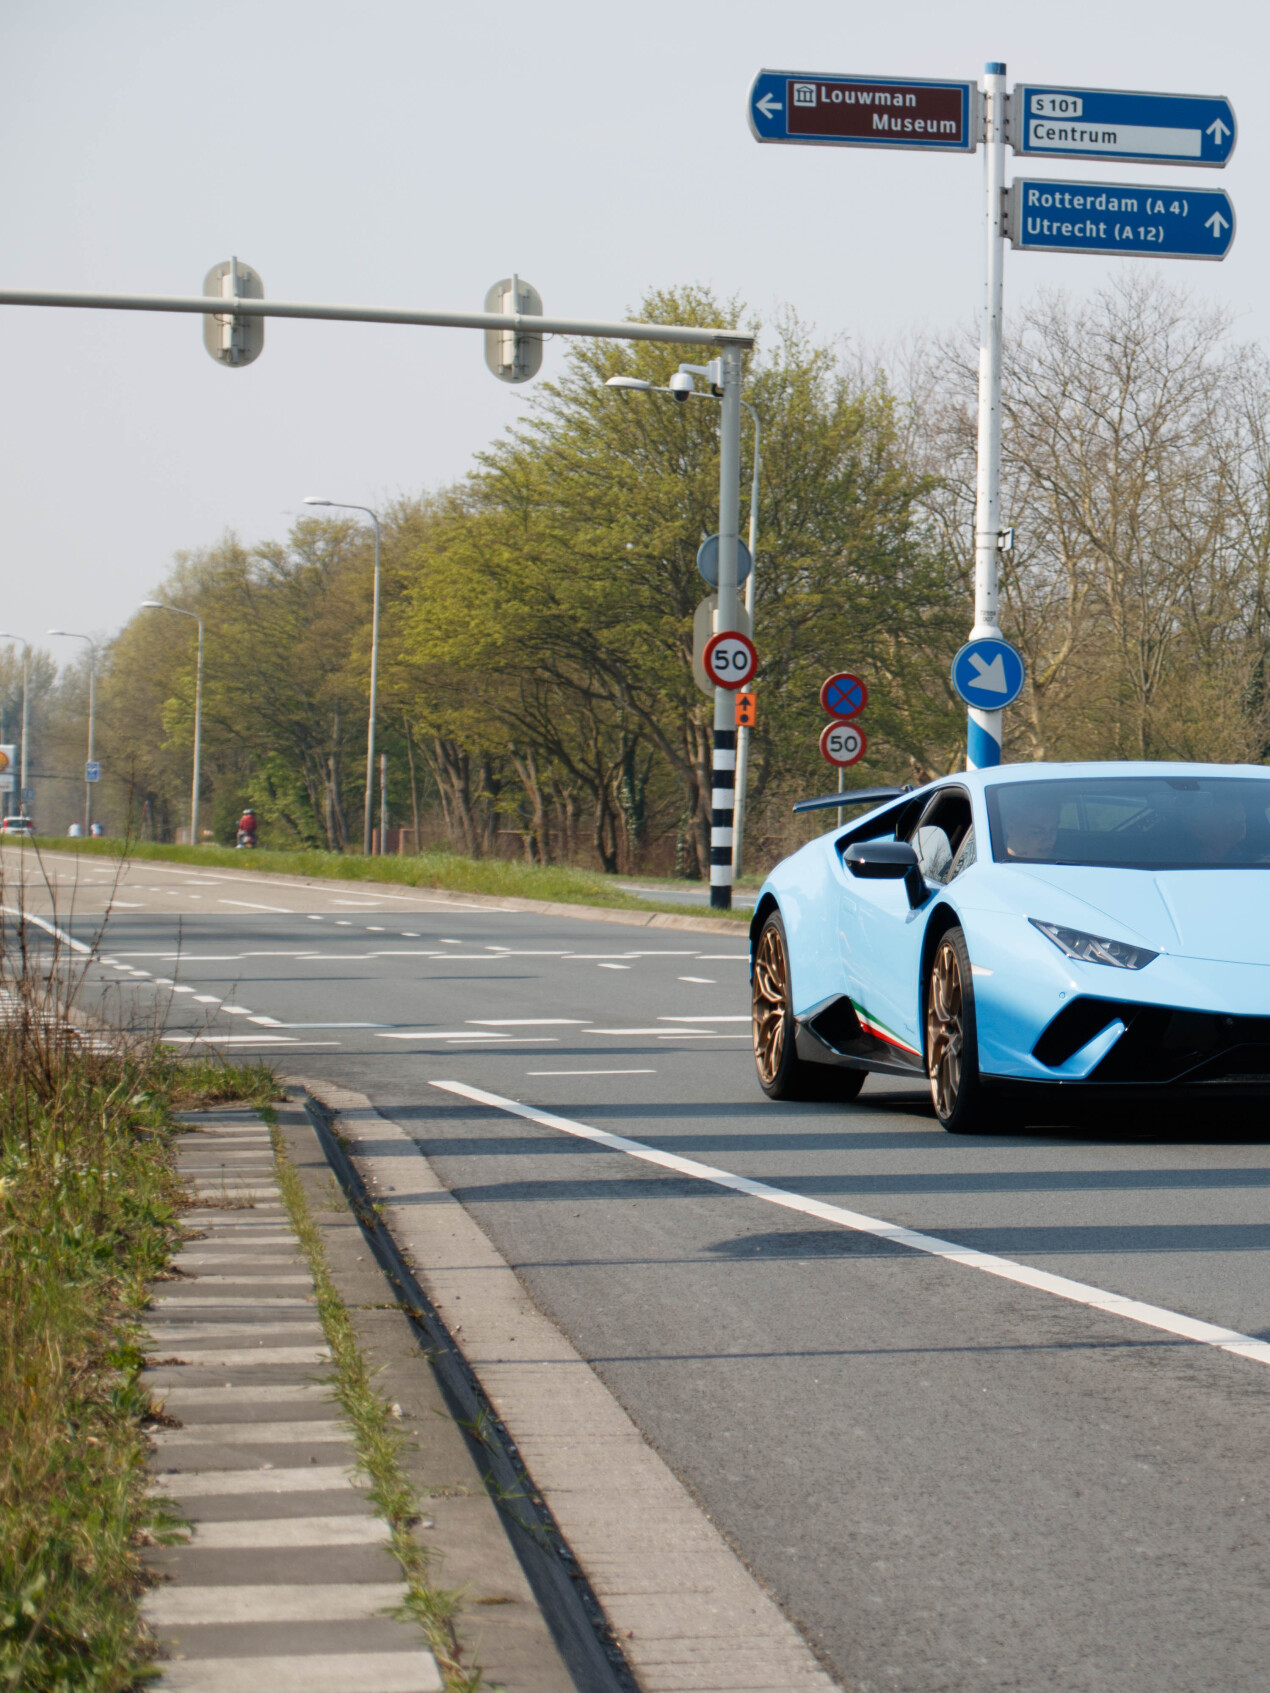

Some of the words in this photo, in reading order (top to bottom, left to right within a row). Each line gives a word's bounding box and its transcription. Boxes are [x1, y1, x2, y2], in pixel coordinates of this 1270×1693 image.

[821, 86, 917, 107] Louwman
[1036, 99, 1044, 111] S
[1049, 99, 1077, 113] 101
[872, 113, 957, 134] Museum
[1033, 124, 1117, 144] Centrum
[1027, 189, 1139, 213] Rotterdam
[1026, 217, 1108, 238] Utrecht
[714, 650, 748, 671] 50
[829, 735, 858, 753] 50
